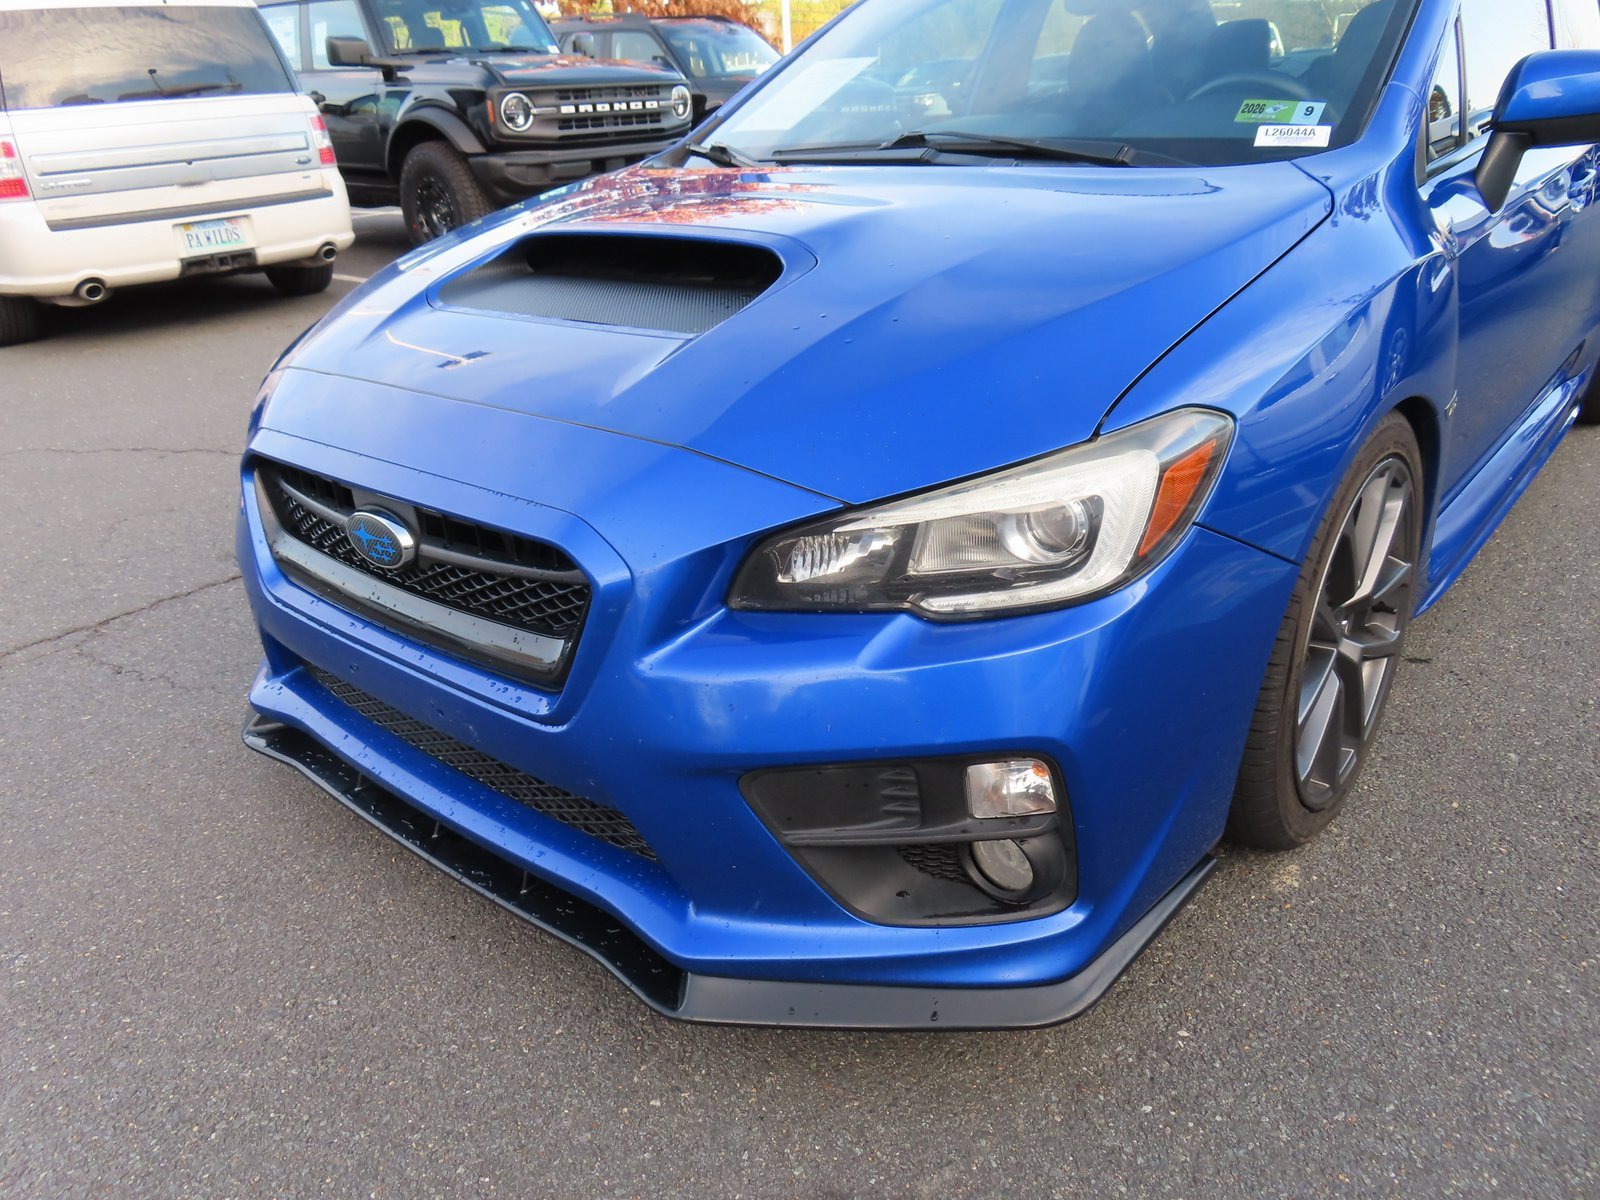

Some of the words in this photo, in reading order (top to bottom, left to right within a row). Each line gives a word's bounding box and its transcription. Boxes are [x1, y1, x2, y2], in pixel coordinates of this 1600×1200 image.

[560, 101, 658, 114] BRONCO
[1241, 103, 1267, 114] 2026
[1303, 106, 1315, 117] 9
[1264, 127, 1316, 137] L26044A
